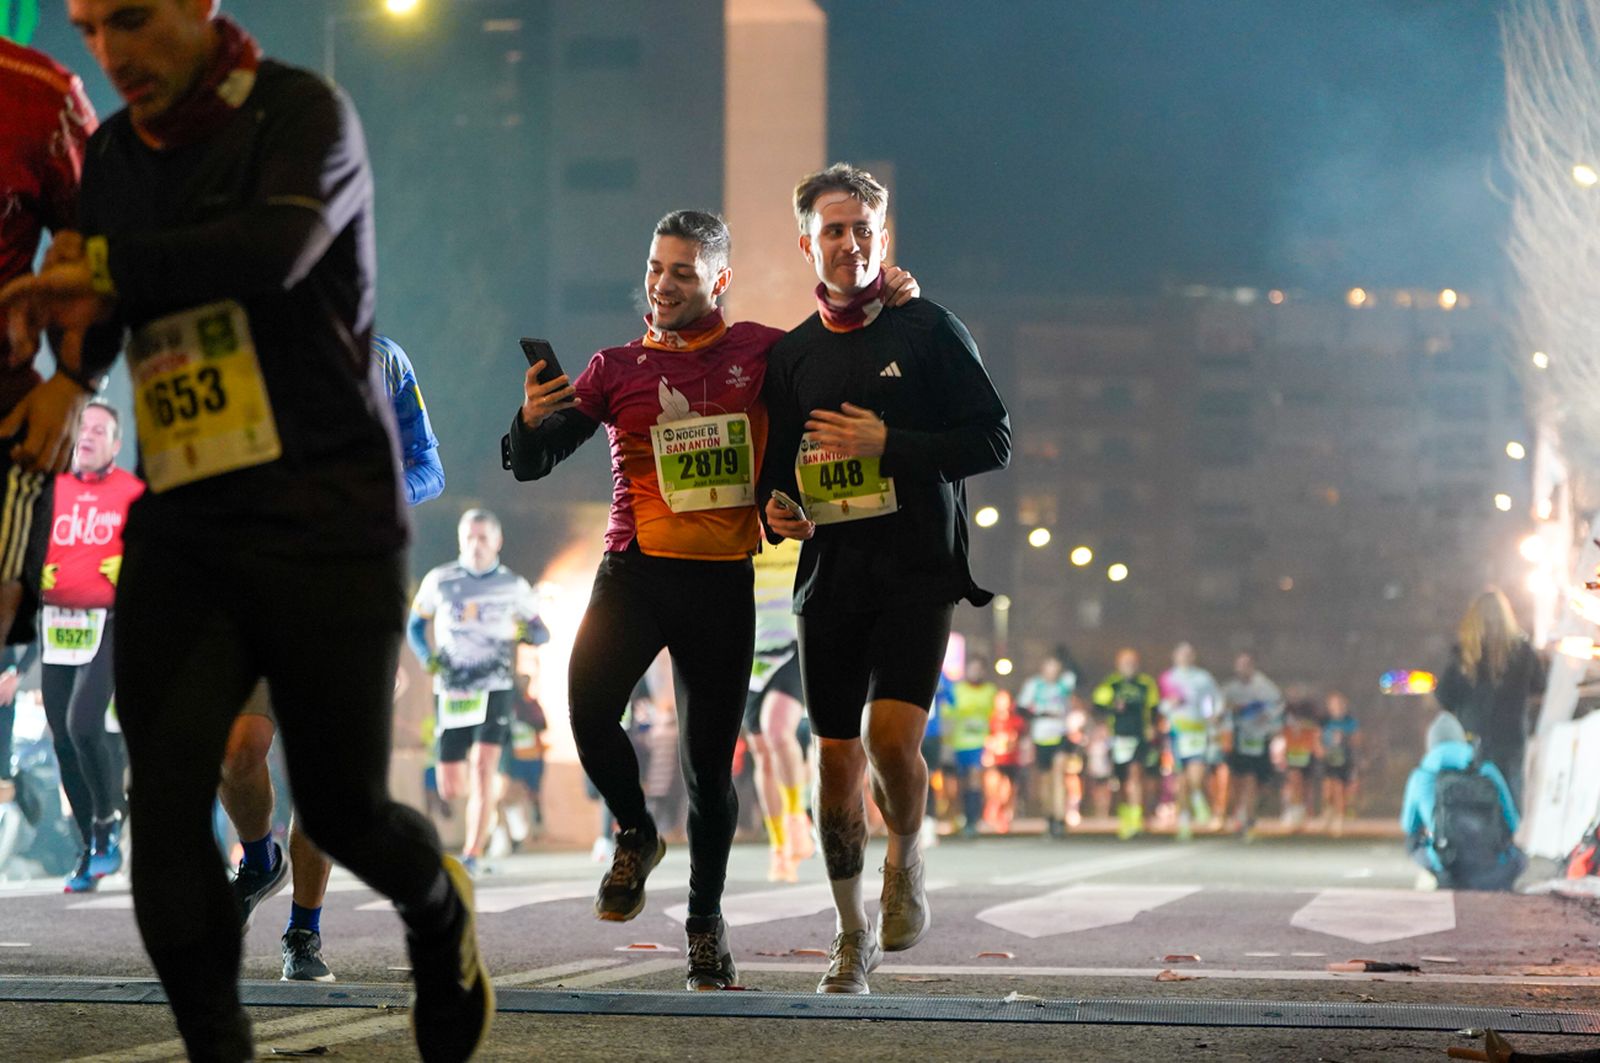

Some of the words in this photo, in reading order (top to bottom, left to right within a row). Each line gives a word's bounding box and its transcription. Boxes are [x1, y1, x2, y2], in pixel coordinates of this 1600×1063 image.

[676, 428, 706, 441] NOCHE
[708, 426, 719, 436] DE
[666, 442, 686, 454] SAN
[678, 447, 739, 480] 2879
[803, 453, 818, 465] SAN
[820, 459, 864, 491] 448
